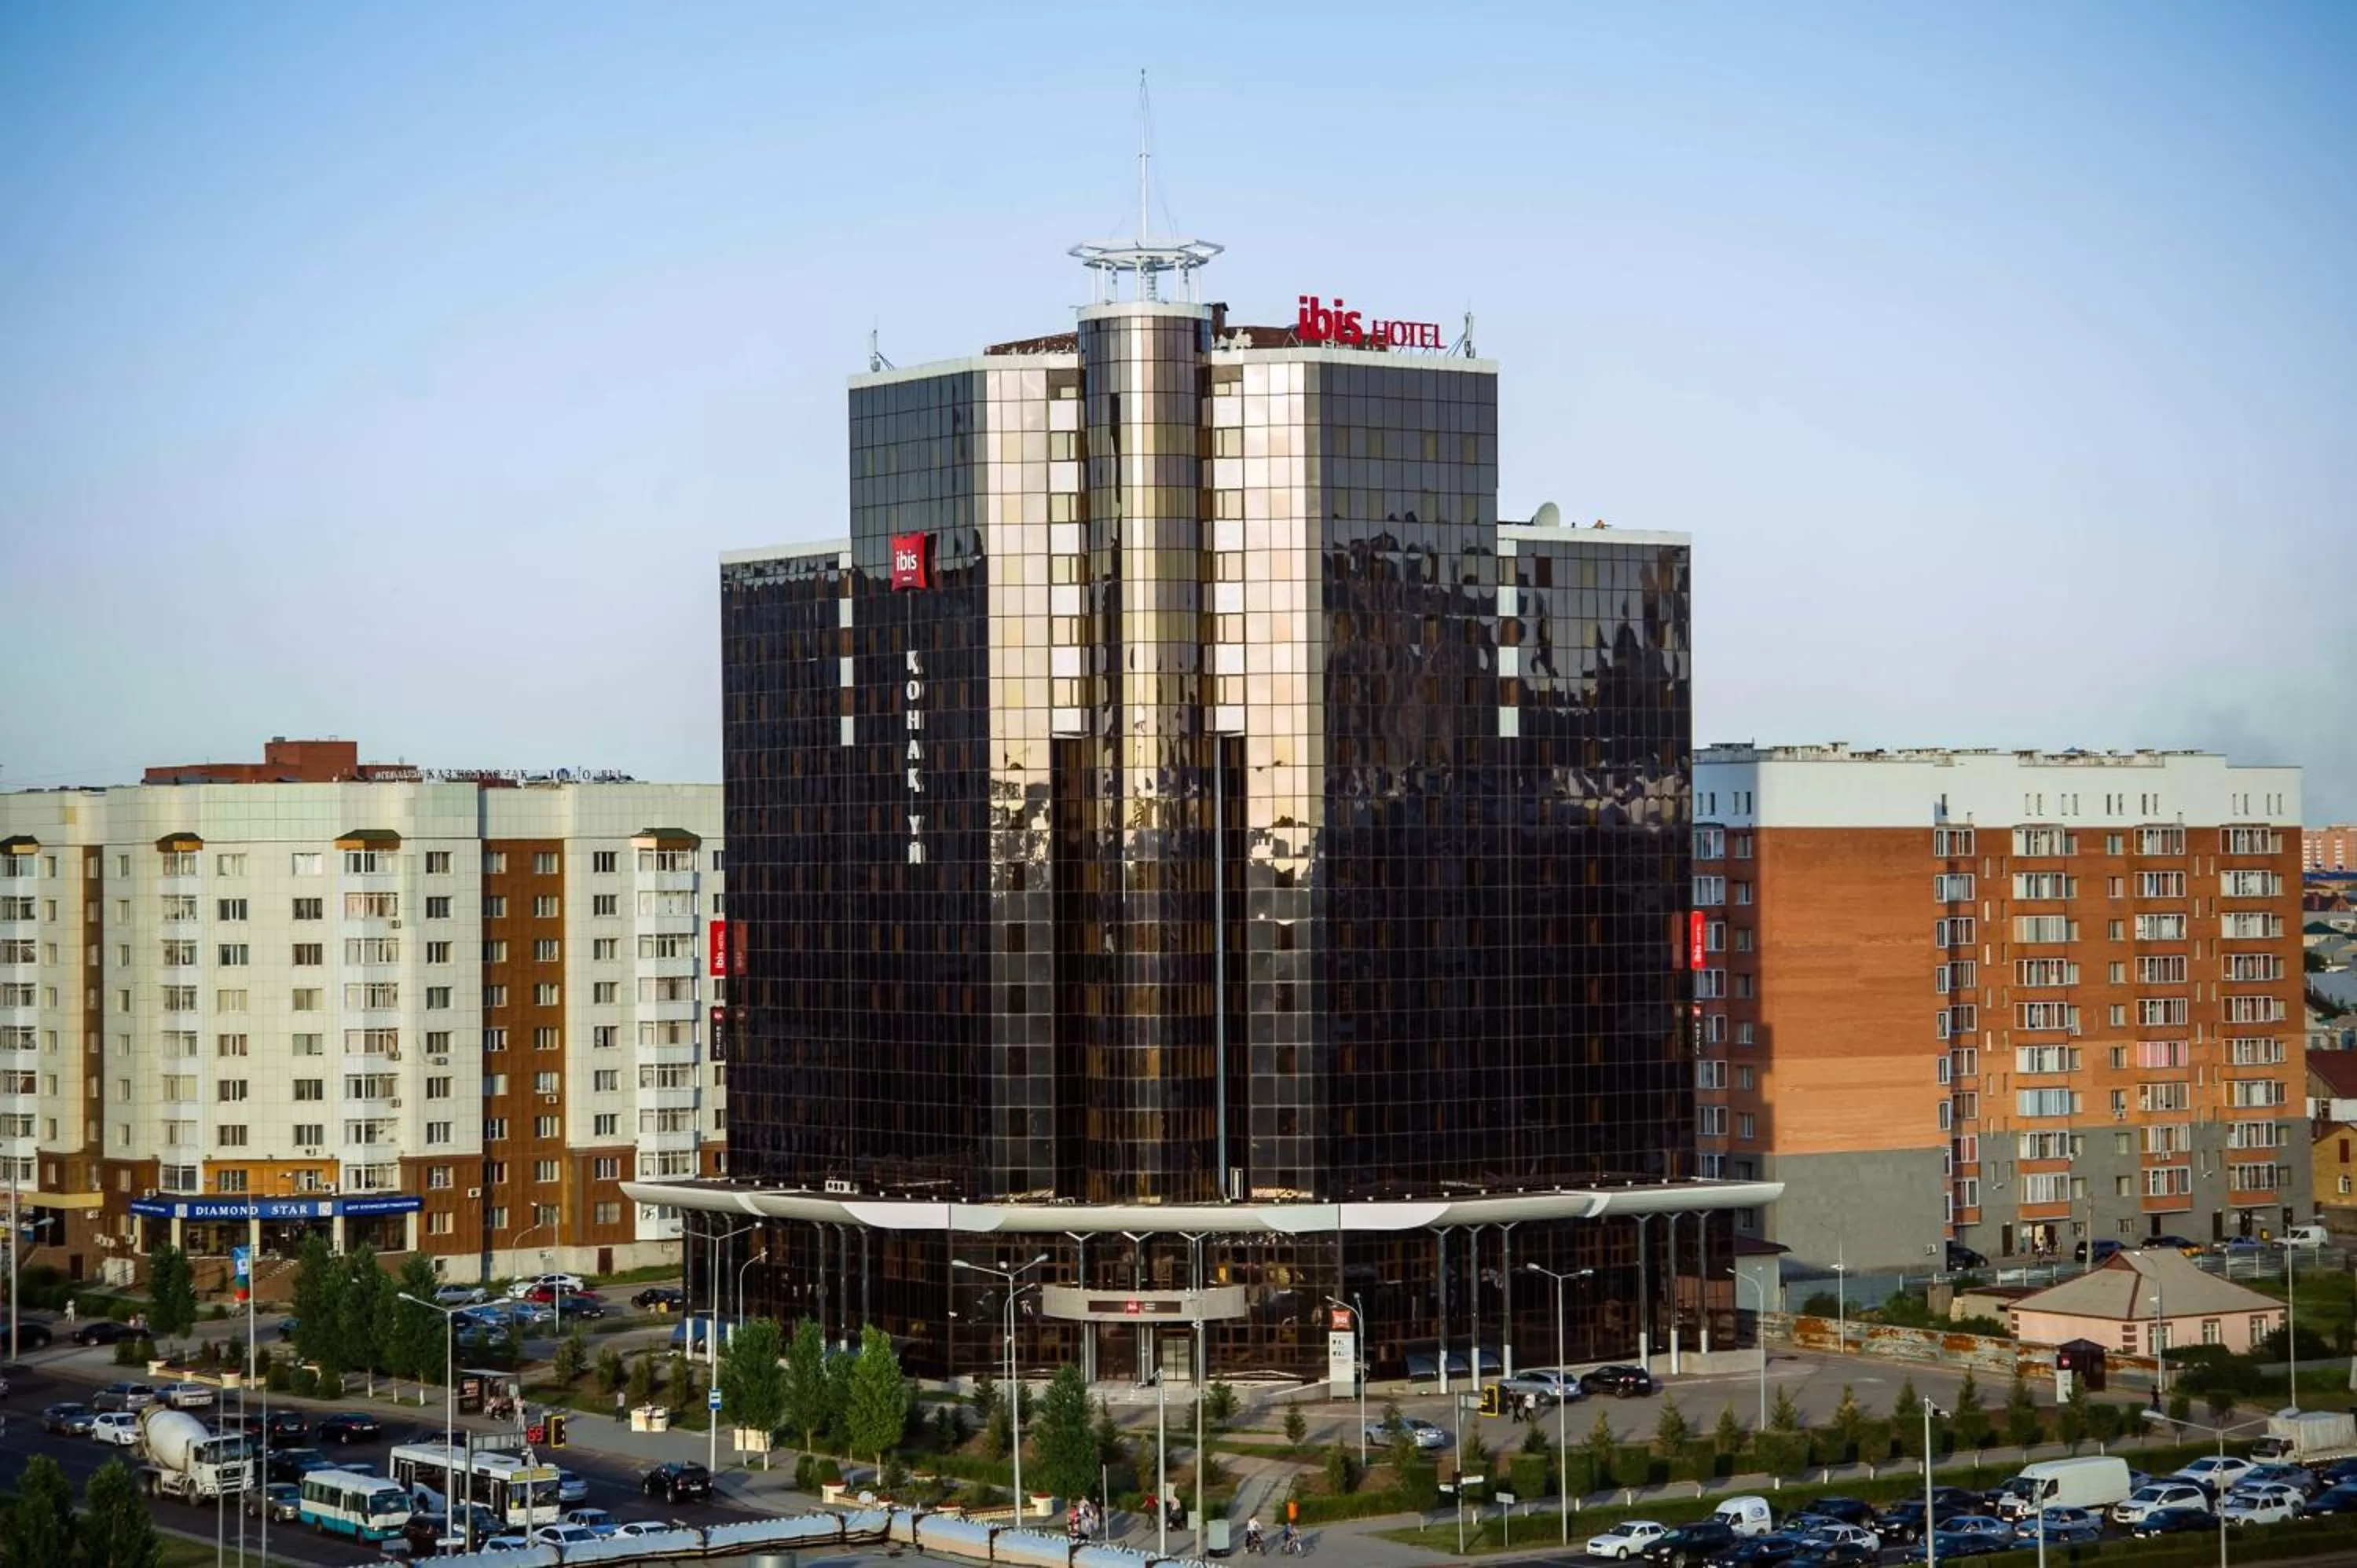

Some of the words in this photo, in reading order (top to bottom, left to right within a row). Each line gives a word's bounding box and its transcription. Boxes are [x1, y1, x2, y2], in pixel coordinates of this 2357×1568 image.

[1299, 295, 1363, 345] ibis
[1372, 319, 1447, 349] HOTEL
[896, 549, 918, 572] ibis
[195, 1205, 259, 1216] DIAMOND
[271, 1204, 308, 1215] STAR
